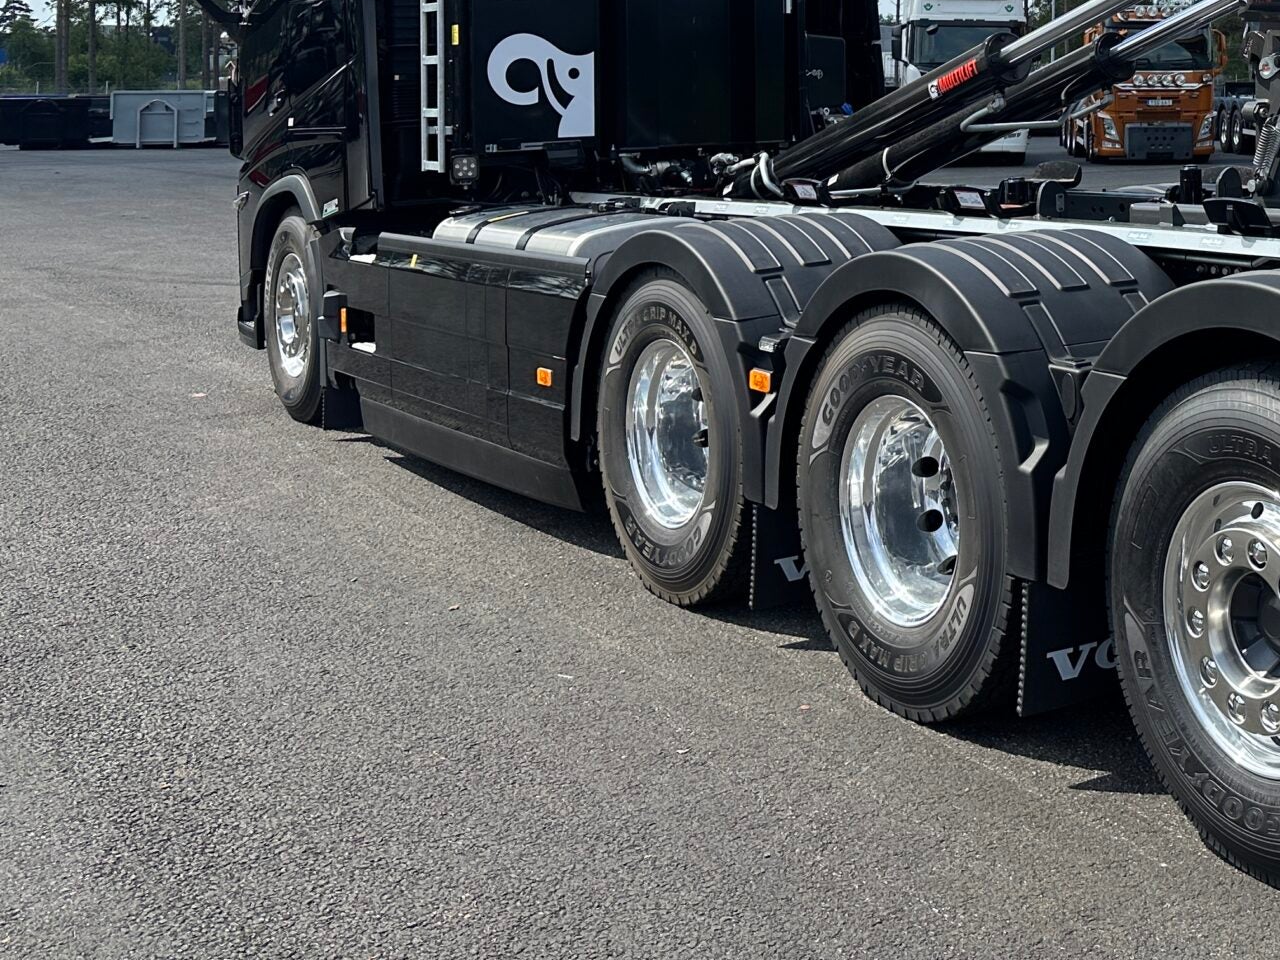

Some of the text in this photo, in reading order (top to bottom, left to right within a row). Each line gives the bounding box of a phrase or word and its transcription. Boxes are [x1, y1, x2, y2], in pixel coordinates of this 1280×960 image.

[938, 58, 979, 94] MULTILIFT
[615, 312, 641, 356] ULTRA
[643, 306, 666, 322] GRIP
[668, 310, 690, 341] MAX
[1208, 434, 1272, 465] ULTRA
[931, 596, 967, 659] ULTRA
[858, 633, 891, 669] MAX
[893, 651, 928, 673] GRIP
